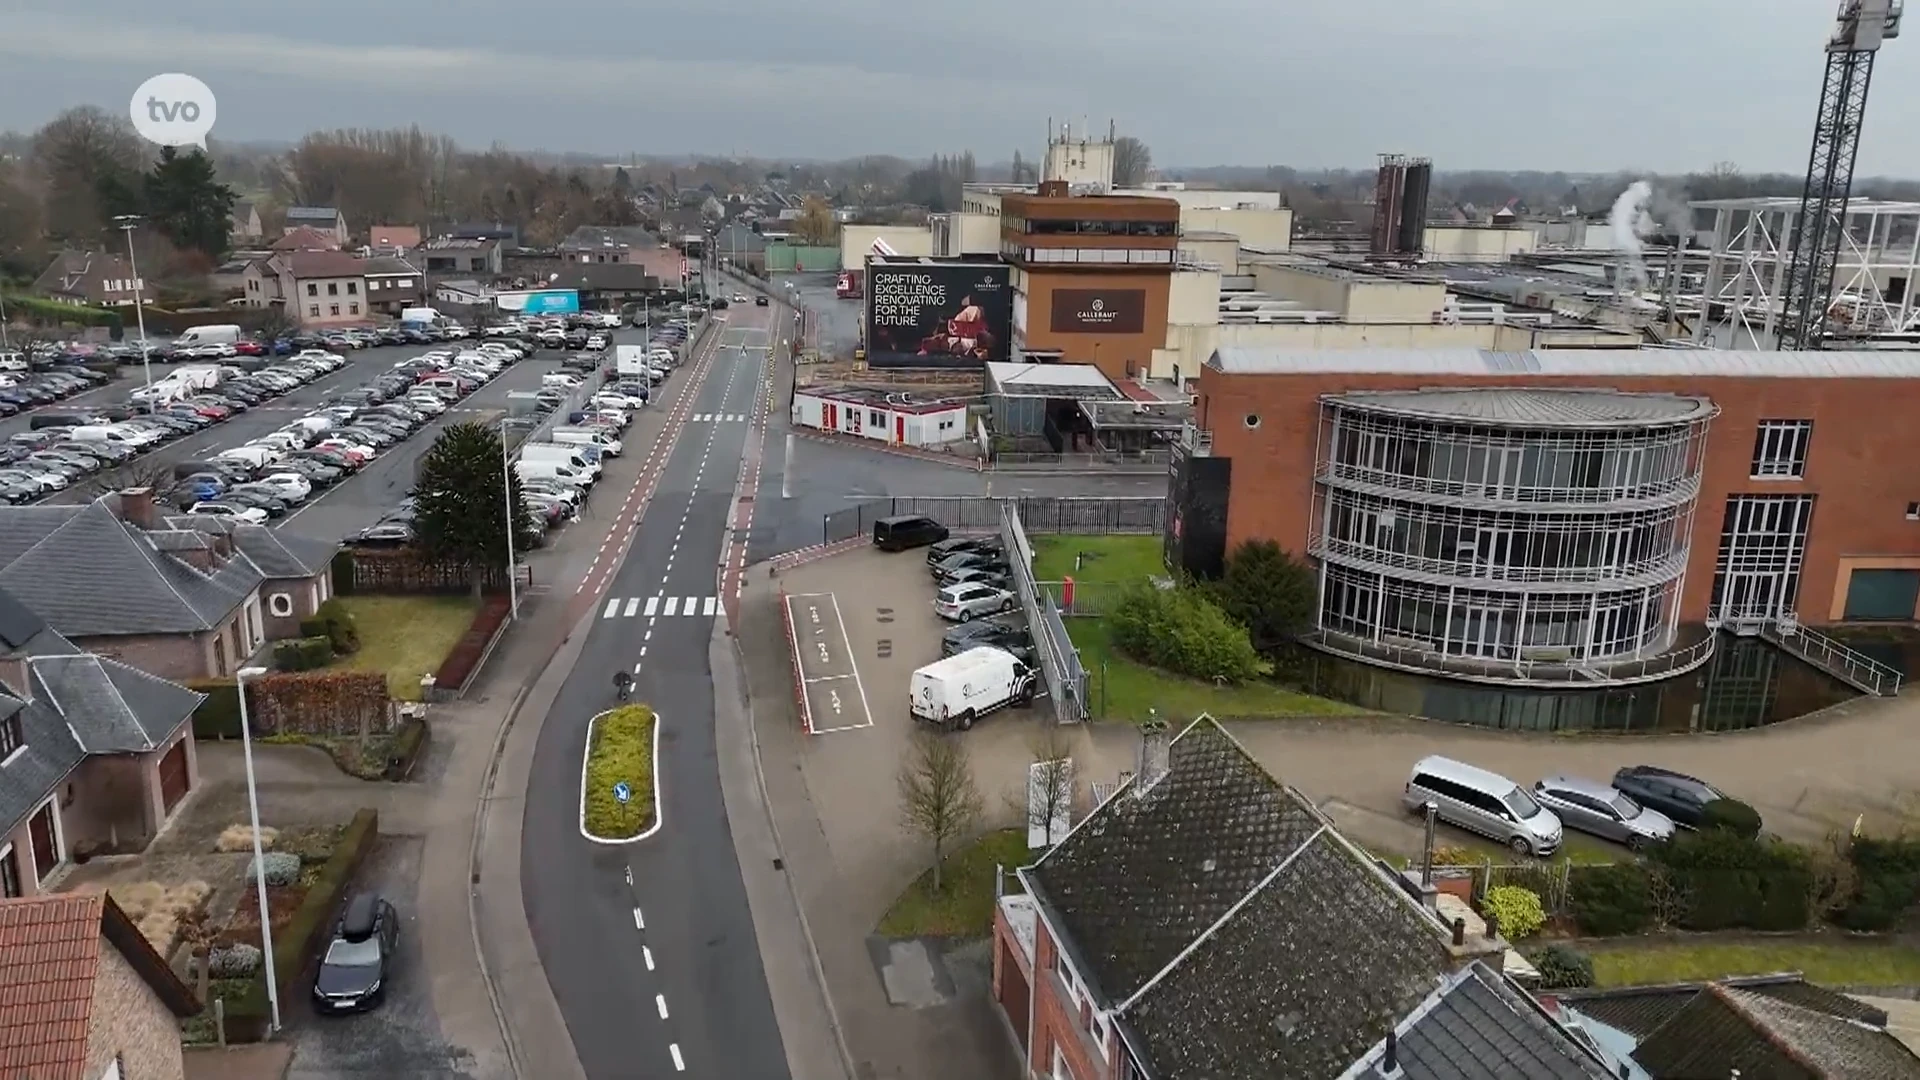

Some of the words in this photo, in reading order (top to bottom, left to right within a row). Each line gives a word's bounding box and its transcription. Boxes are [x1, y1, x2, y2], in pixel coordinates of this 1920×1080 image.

[875, 274, 931, 285] CRAFTING
[875, 285, 945, 295] EXCELLENCE
[875, 295, 946, 305] RENOVATING
[875, 305, 897, 315] FOR
[900, 305, 920, 315] THE
[875, 316, 918, 326] FUTURE.
